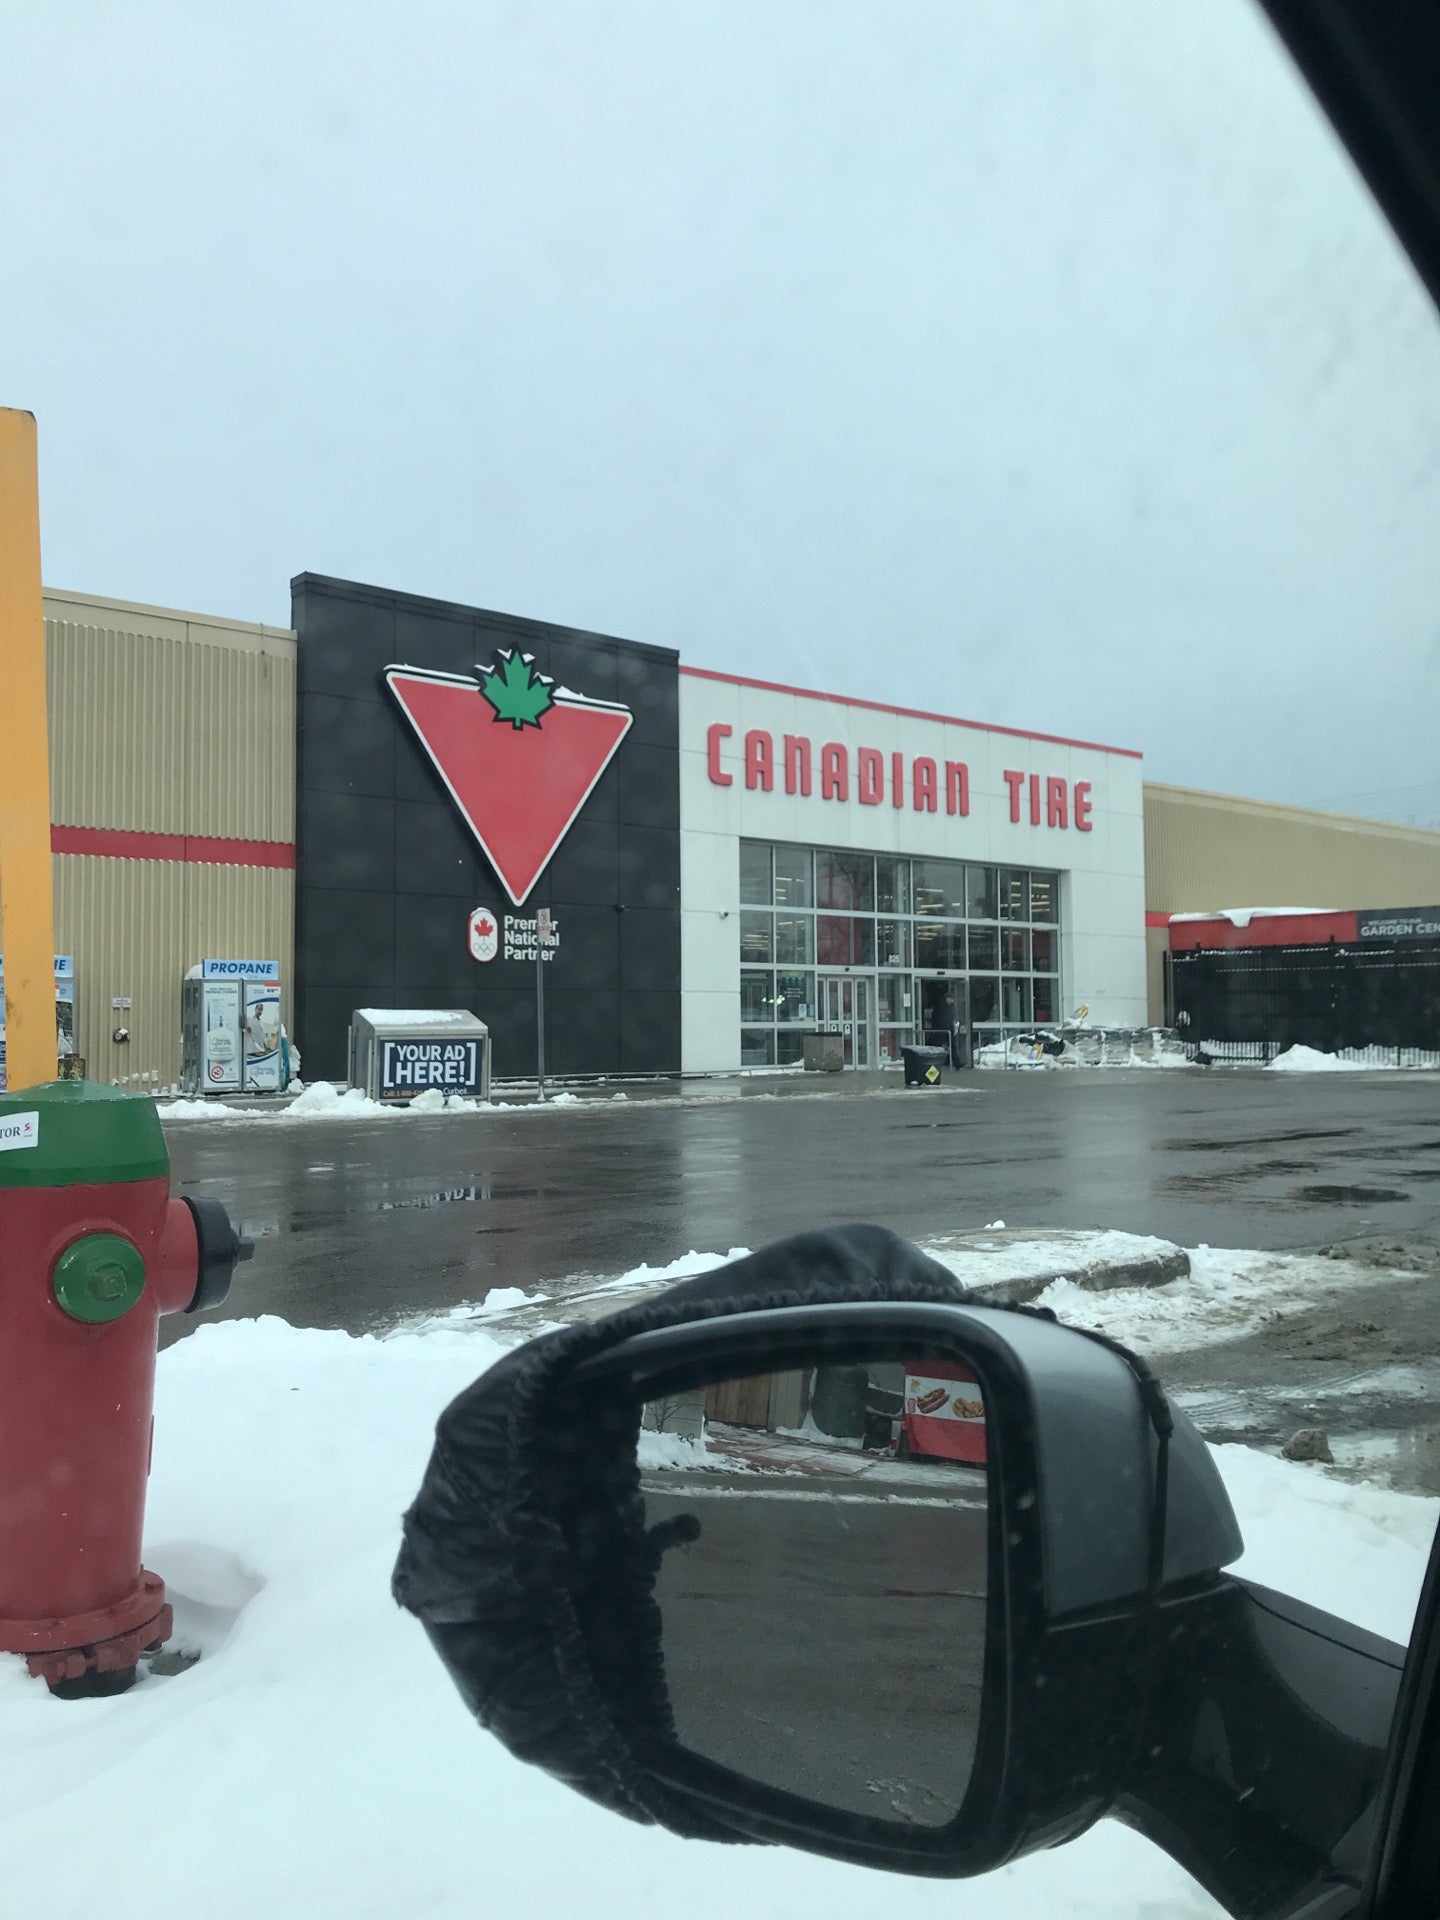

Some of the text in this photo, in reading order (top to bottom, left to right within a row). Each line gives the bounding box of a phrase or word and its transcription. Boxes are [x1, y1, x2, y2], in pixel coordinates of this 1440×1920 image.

[707, 723, 1093, 832] CANADIAN TIRE
[504, 914, 559, 931] Premr
[1361, 924, 1413, 937] GARDEN
[210, 962, 273, 974] PROPANE
[396, 1044, 466, 1061] YOUR AD
[395, 1061, 465, 1084] HERE!
